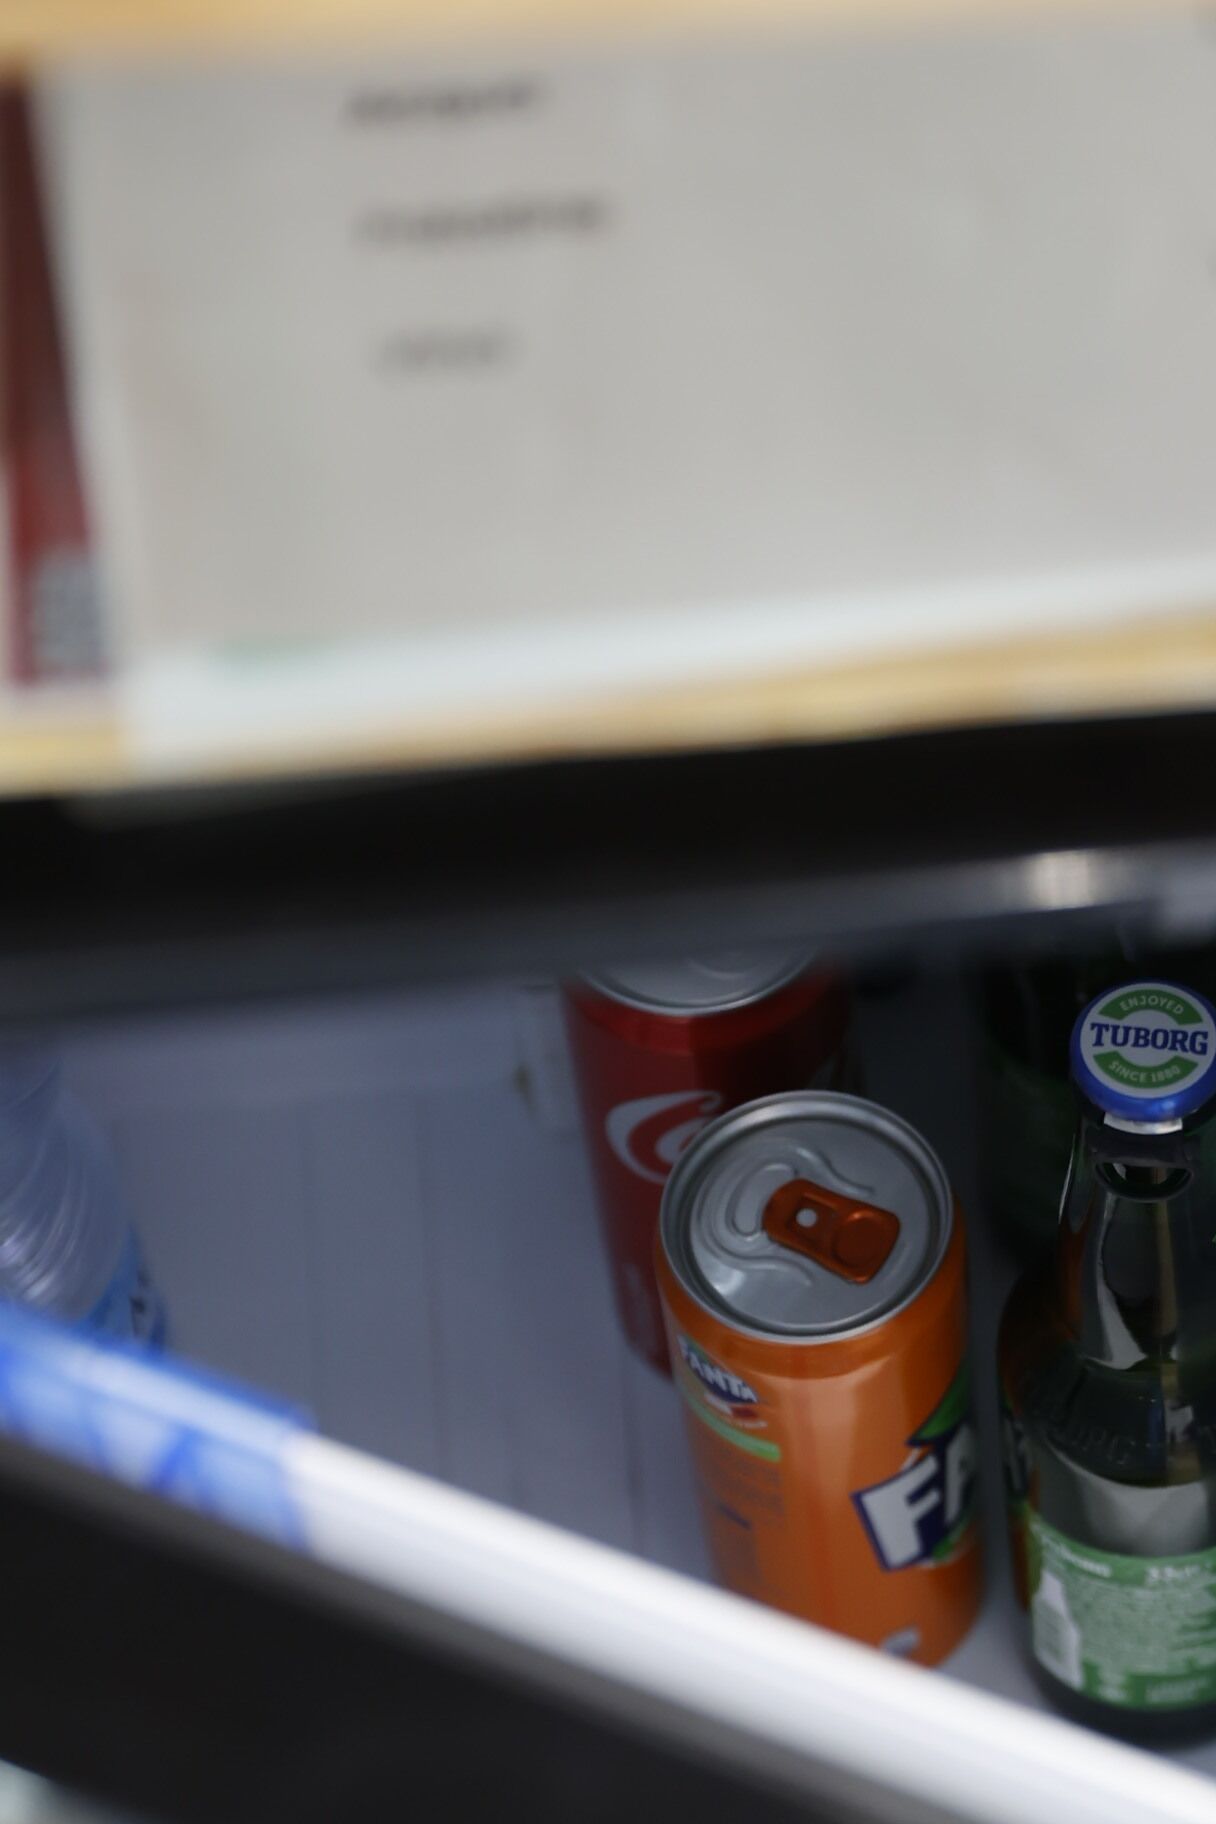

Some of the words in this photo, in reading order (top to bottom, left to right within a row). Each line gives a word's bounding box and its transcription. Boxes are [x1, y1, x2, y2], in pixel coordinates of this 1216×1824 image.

[1119, 995, 1184, 1015] ENJOYED
[1090, 1022, 1208, 1055] TUBORG
[1108, 1061, 1147, 1083] SINCE
[1151, 1065, 1181, 1083] 1880
